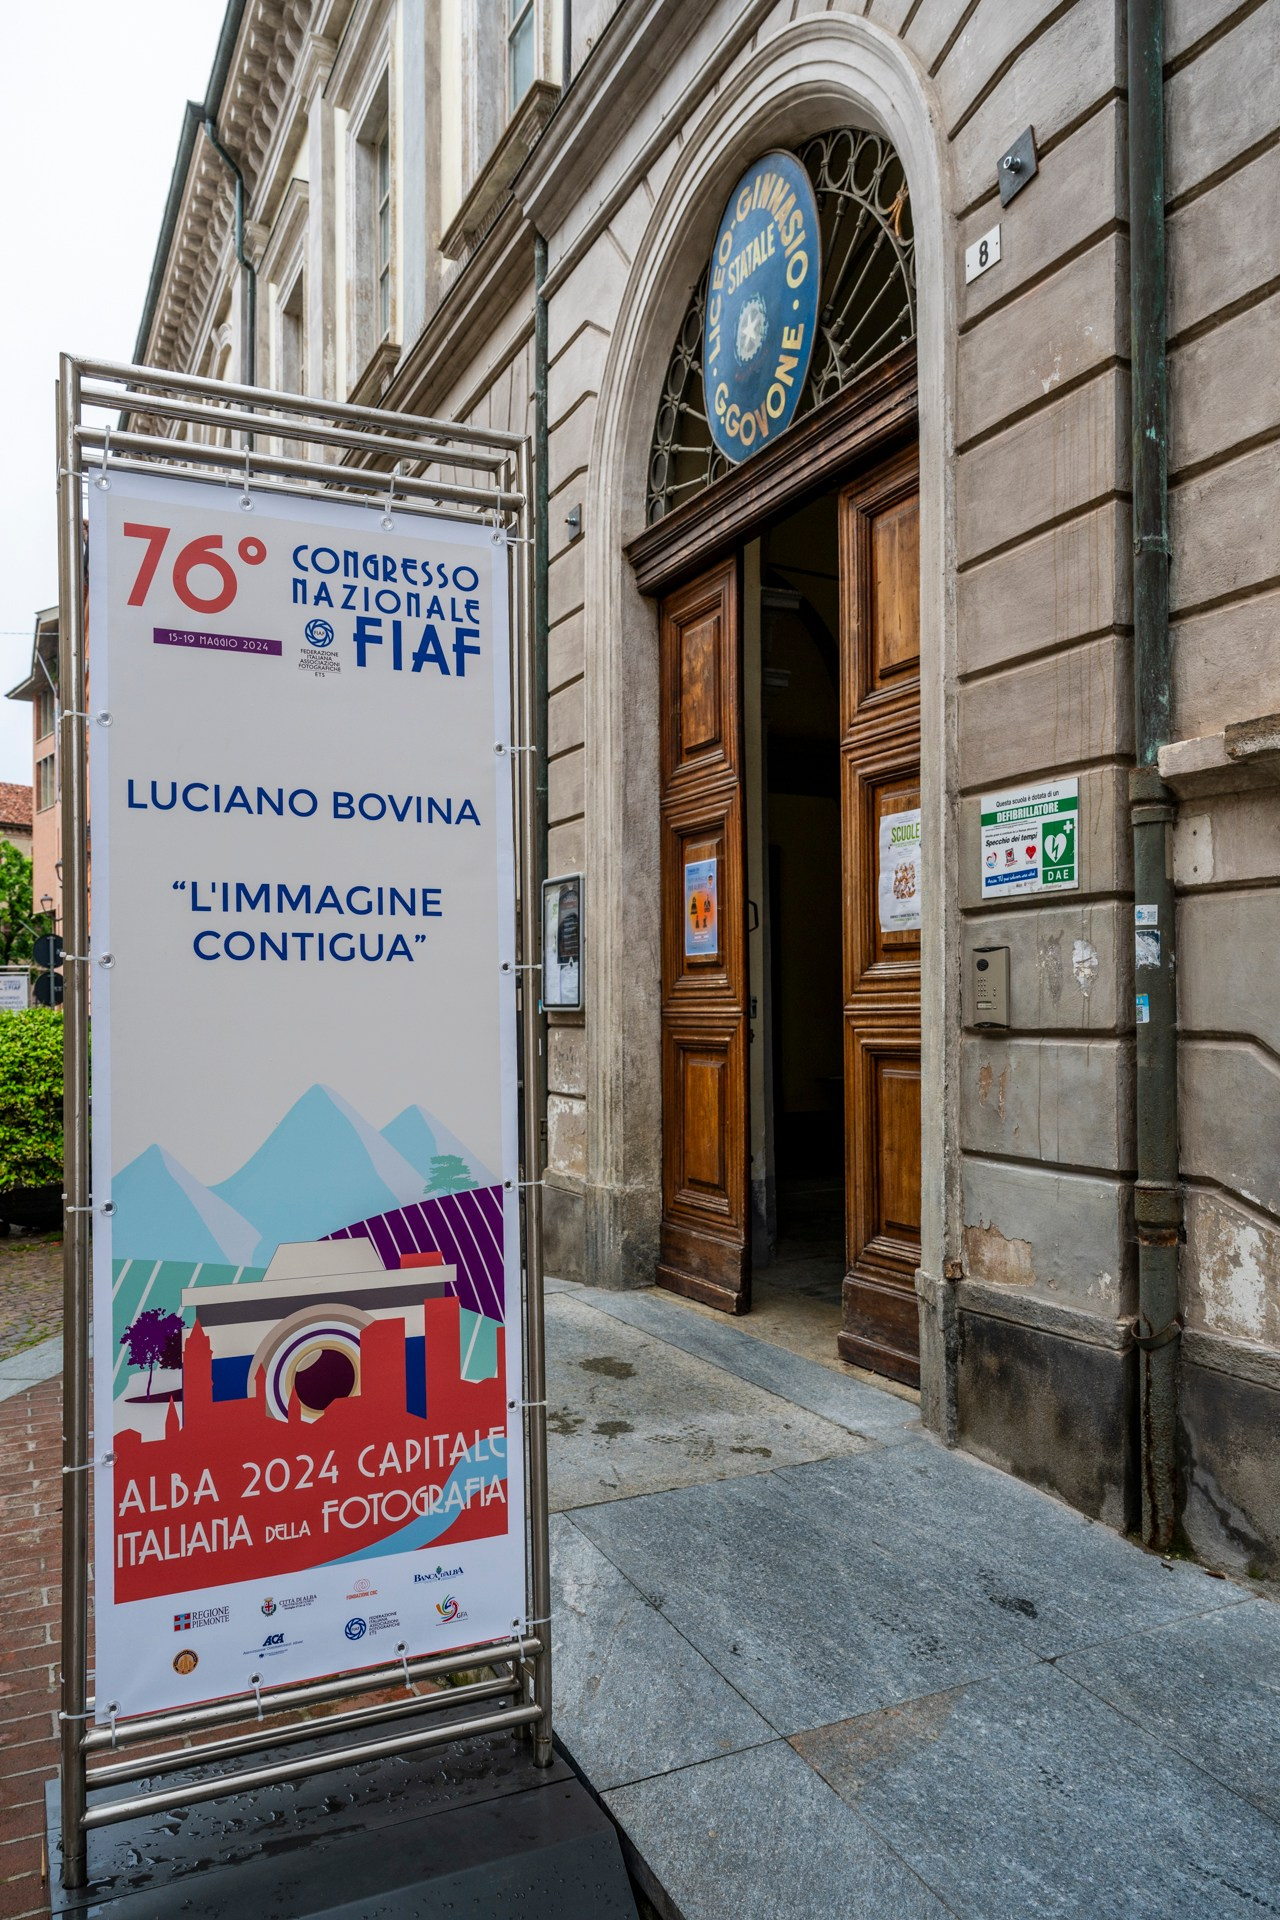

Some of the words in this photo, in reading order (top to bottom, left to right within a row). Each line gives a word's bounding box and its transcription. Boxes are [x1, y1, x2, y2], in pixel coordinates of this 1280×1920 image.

[728, 222, 776, 295] STATALE
[979, 240, 989, 268] 8
[123, 522, 267, 614] 76°
[292, 544, 479, 592] CONGRESSO
[292, 577, 480, 625] NAZIONALE
[168, 632, 195, 644] 15-19
[200, 635, 238, 648] MAGGIO
[243, 640, 269, 651] 2024
[353, 616, 481, 677] FIAF
[300, 648, 339, 657] FEDERAZIONE
[307, 654, 333, 662] ITALIANA
[298, 663, 341, 672] FOTOGRAFICHE
[300, 659, 341, 667] ASSOCIAZIONI
[127, 779, 318, 818] LUCIANO
[332, 791, 481, 826] BOVINA
[996, 800, 1012, 808] Questa
[1012, 796, 1027, 805] scuola
[1032, 792, 1047, 801] dotata
[997, 802, 1059, 822] DEFIBRILLATORE
[891, 822, 920, 843] SCUOLE
[985, 836, 1010, 848] Specchio
[1011, 834, 1020, 844] dei
[1021, 831, 1038, 842] tempi
[118, 1468, 220, 1518] ALBA
[240, 1450, 339, 1499] 2024
[357, 1425, 506, 1479] CAPITALE
[117, 1514, 254, 1569] ITALIANA
[265, 1519, 311, 1544] DELLA
[321, 1473, 507, 1534] FOTOGRAFIA
[414, 1571, 438, 1583] BANCA
[303, 1594, 318, 1602] ALBA
[346, 1591, 370, 1600] FONDAZIONE
[192, 1605, 230, 1620] REGIONE
[368, 1611, 397, 1620] FEDERAZIONE
[192, 1614, 230, 1629] PIEMONTE
[368, 1619, 399, 1628] ASSOCIAZIONI
[368, 1622, 400, 1631] FOTOGRAFICHE
[262, 1633, 285, 1647] ACA
